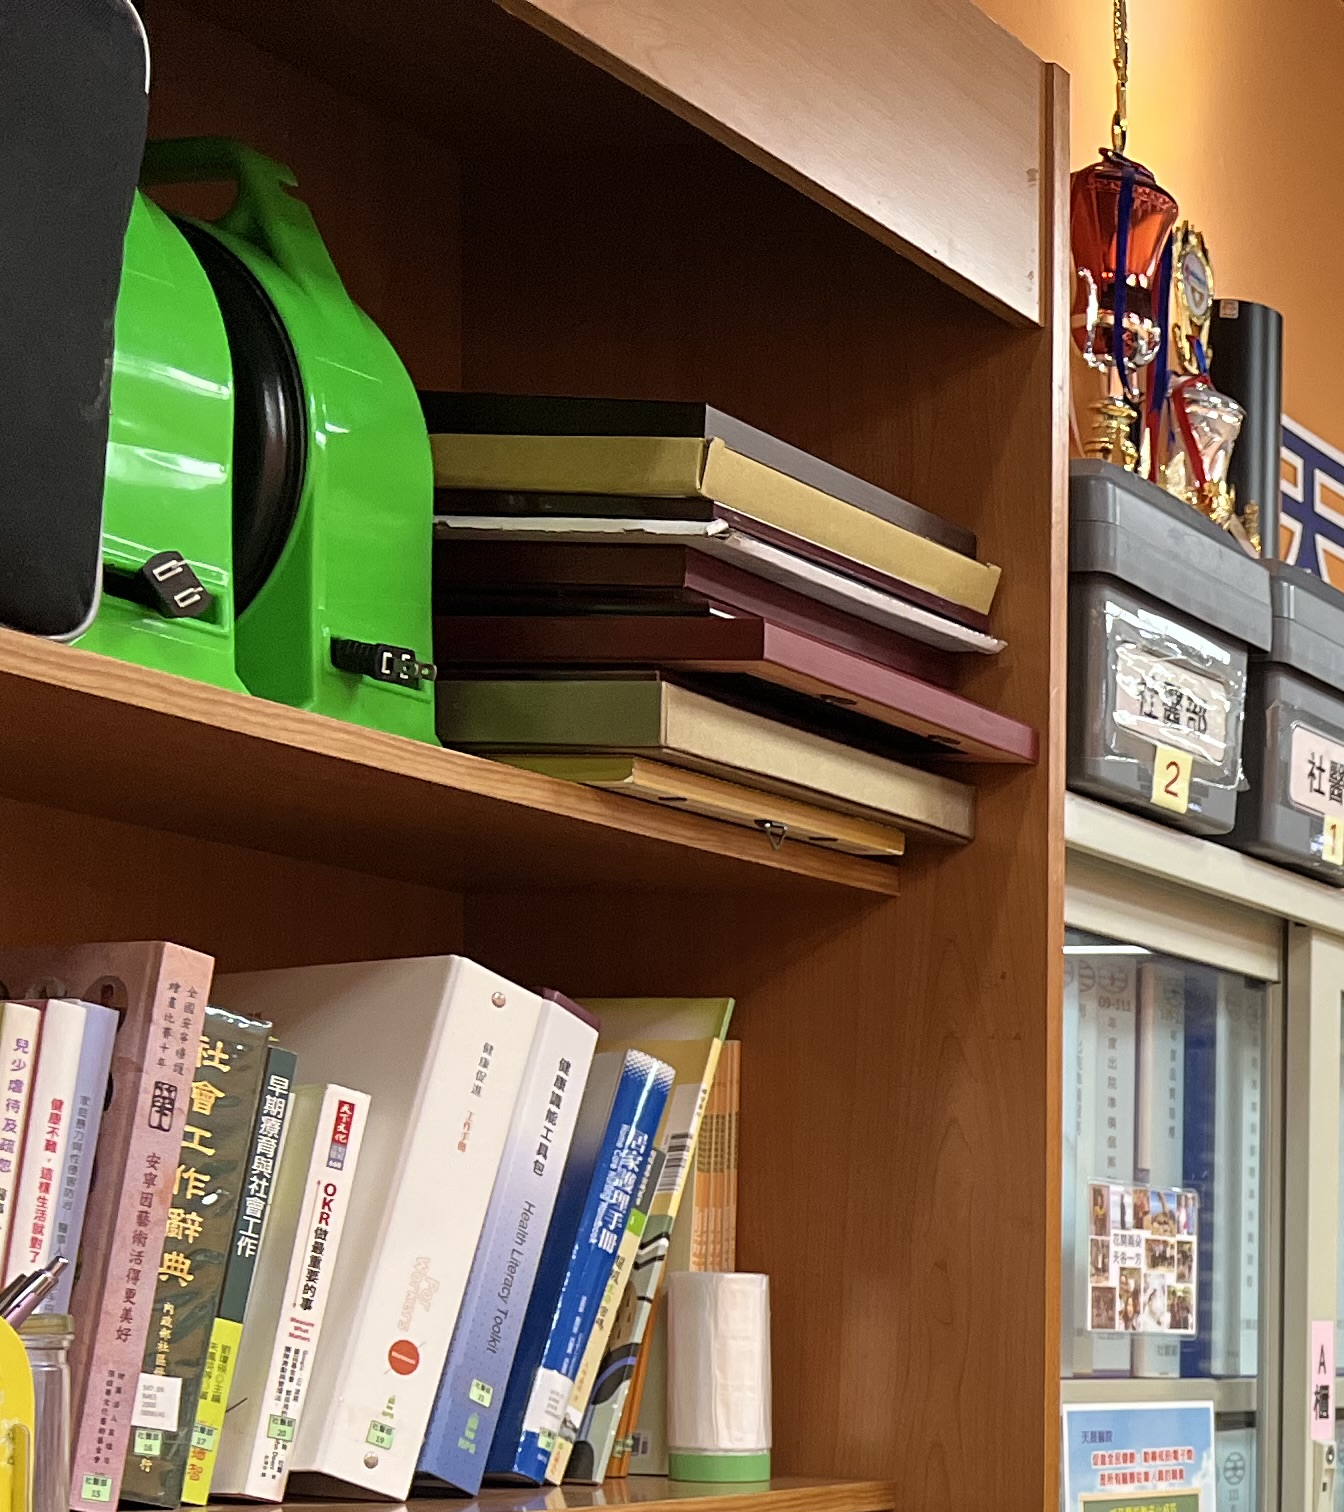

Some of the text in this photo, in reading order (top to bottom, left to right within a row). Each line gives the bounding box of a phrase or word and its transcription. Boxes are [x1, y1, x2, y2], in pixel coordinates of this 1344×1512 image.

[1164, 761, 1180, 797] 2
[1331, 825, 1337, 855] 1
[470, 1042, 494, 1098] 健康促進
[335, 1103, 352, 1143] 天下文化
[533, 1057, 571, 1177] 健康識能工具包
[159, 1035, 231, 1288] 社會工作辭典
[236, 1074, 290, 1258] 早期療育與社會工作
[115, 1152, 161, 1343] 安寧因藝術活得更美好
[486, 1200, 536, 1355] Health Literacy Toolkit
[276, 1429, 287, 1438] 20
[375, 1435, 385, 1444] 19
[139, 1457, 153, 1473] 行
[91, 1488, 102, 1498] 15
